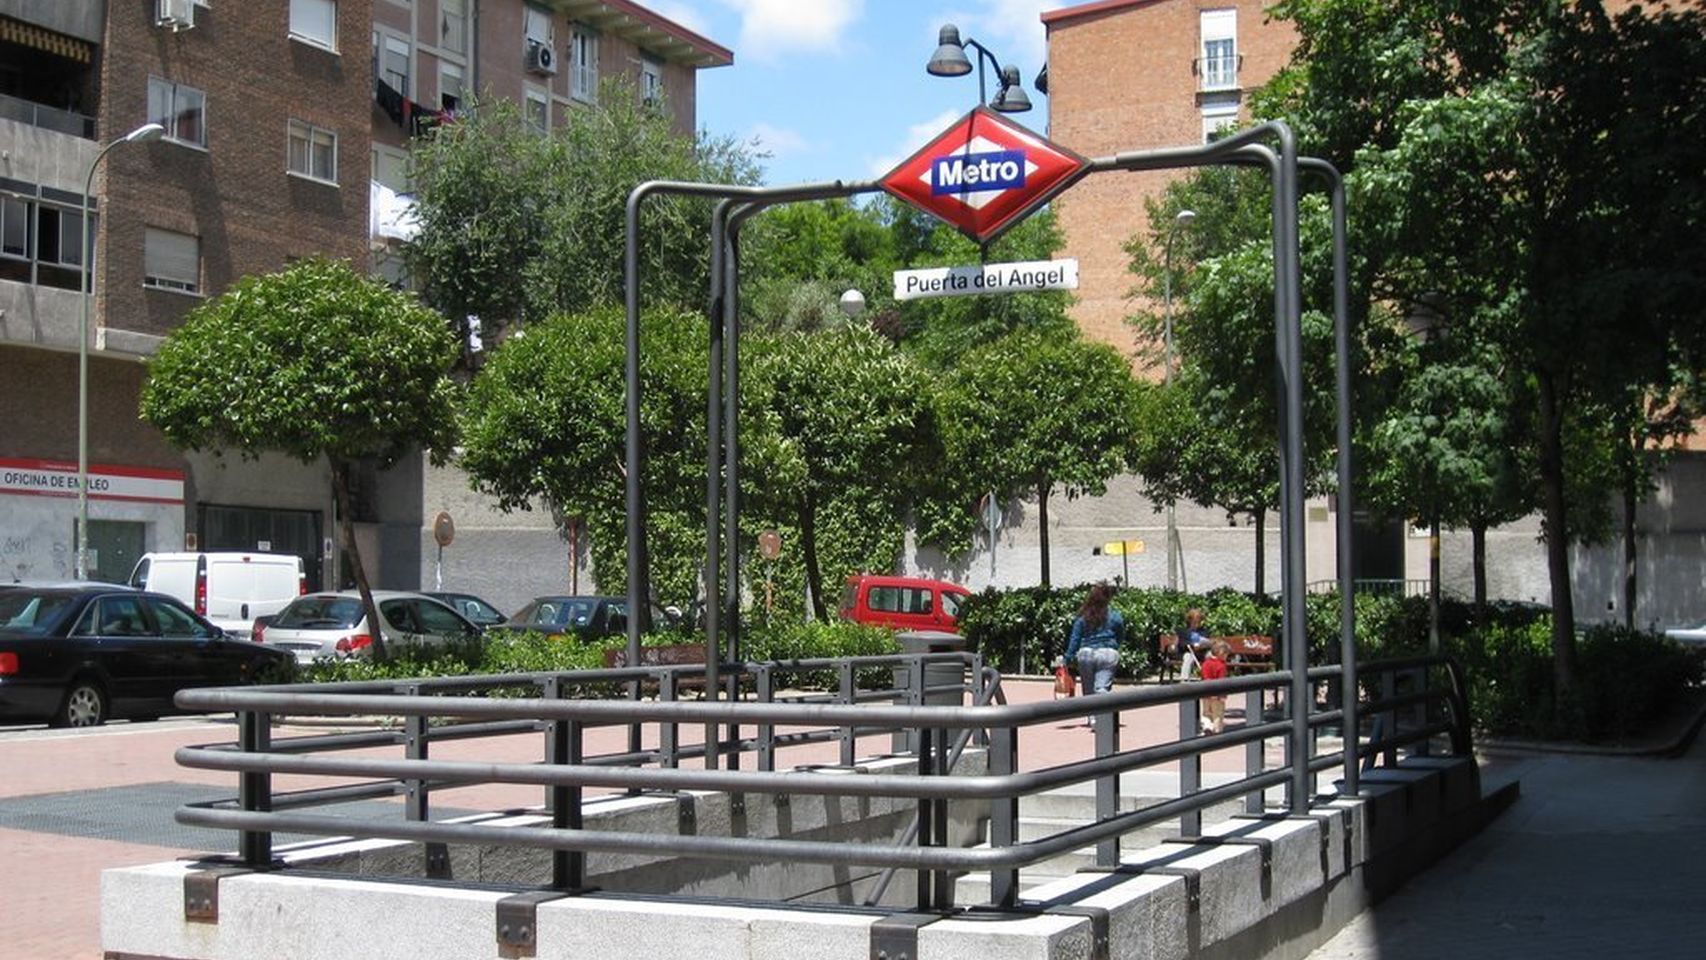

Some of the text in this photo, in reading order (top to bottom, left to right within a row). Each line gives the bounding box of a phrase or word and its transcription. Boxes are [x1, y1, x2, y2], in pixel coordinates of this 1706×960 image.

[939, 159, 1019, 187] Metro
[906, 265, 1064, 293] Puerta del Angel
[4, 472, 109, 490] OFICINA DE EMLEO
